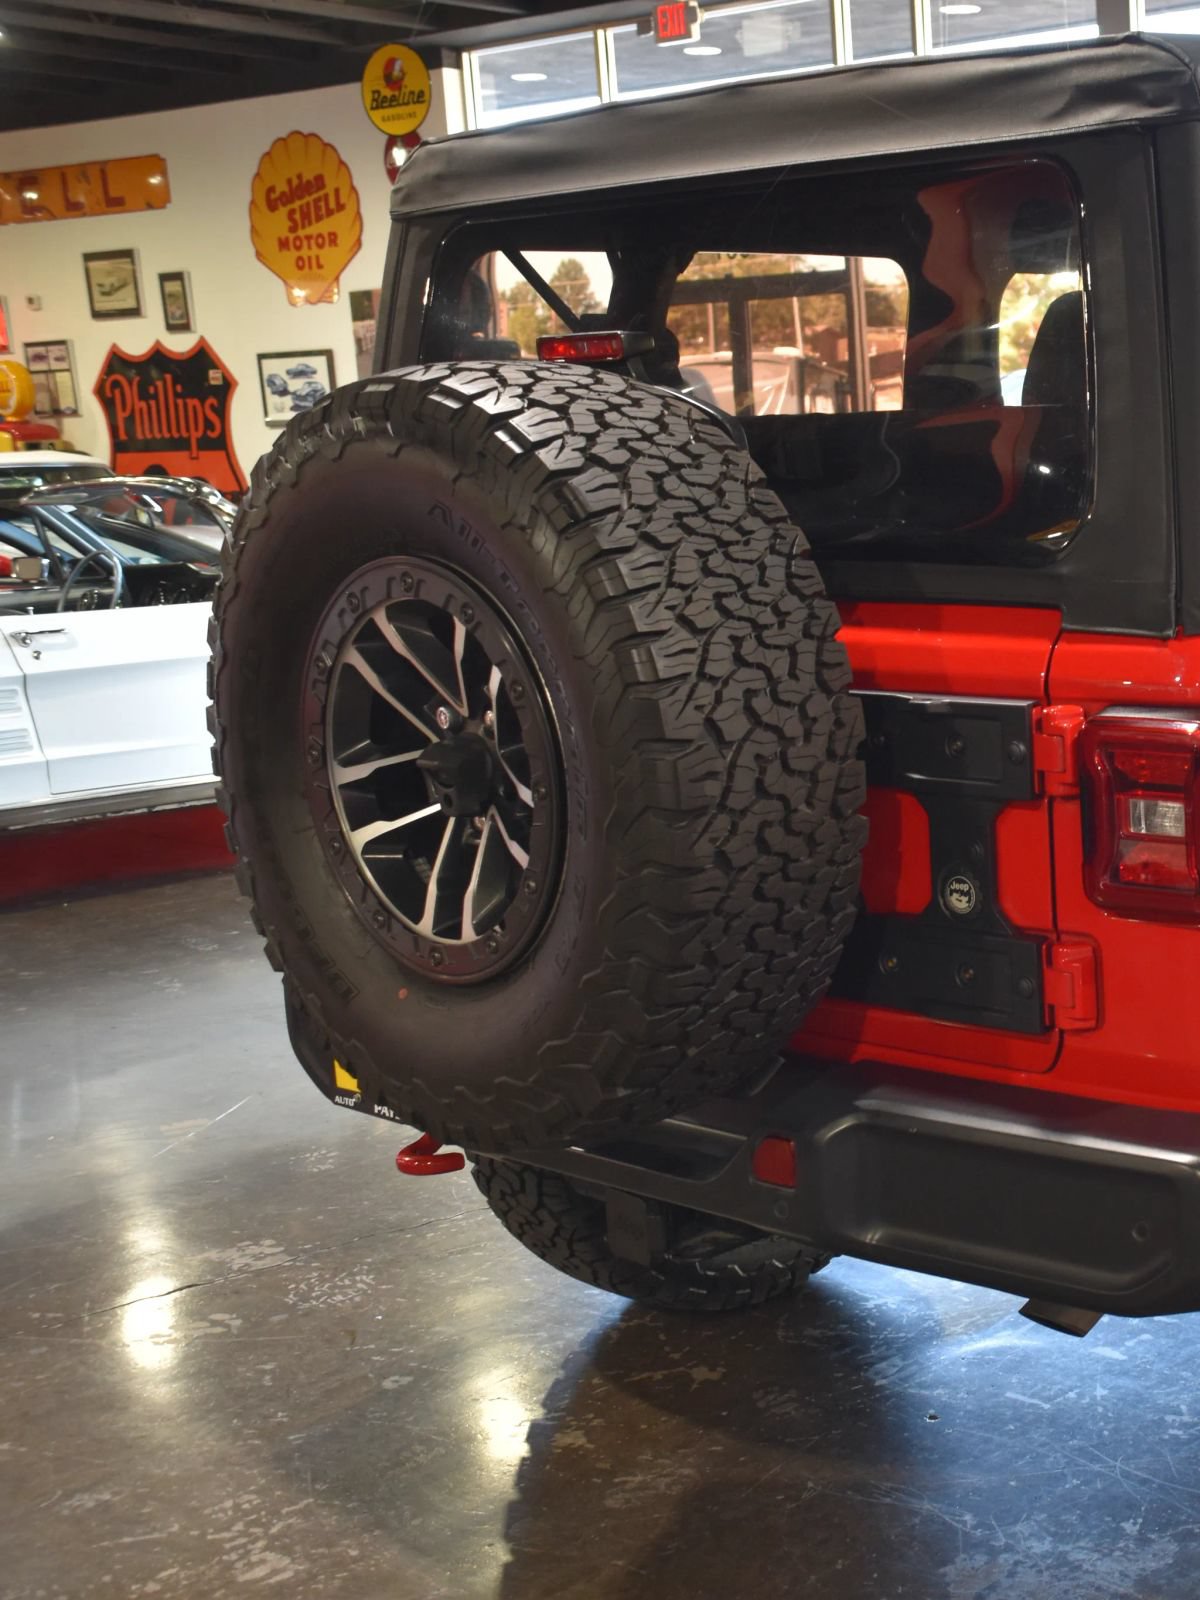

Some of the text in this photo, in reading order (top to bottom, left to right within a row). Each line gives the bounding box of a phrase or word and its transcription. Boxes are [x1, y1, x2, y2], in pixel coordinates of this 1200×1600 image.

[657, 2, 687, 38] EXIT
[370, 84, 426, 111] Beeline
[265, 173, 326, 213] Golden
[287, 187, 347, 234] SHELL
[277, 231, 339, 253] MOTOR
[295, 255, 324, 271] OIL
[105, 373, 222, 459] Phillips
[950, 880, 969, 892] Jeep
